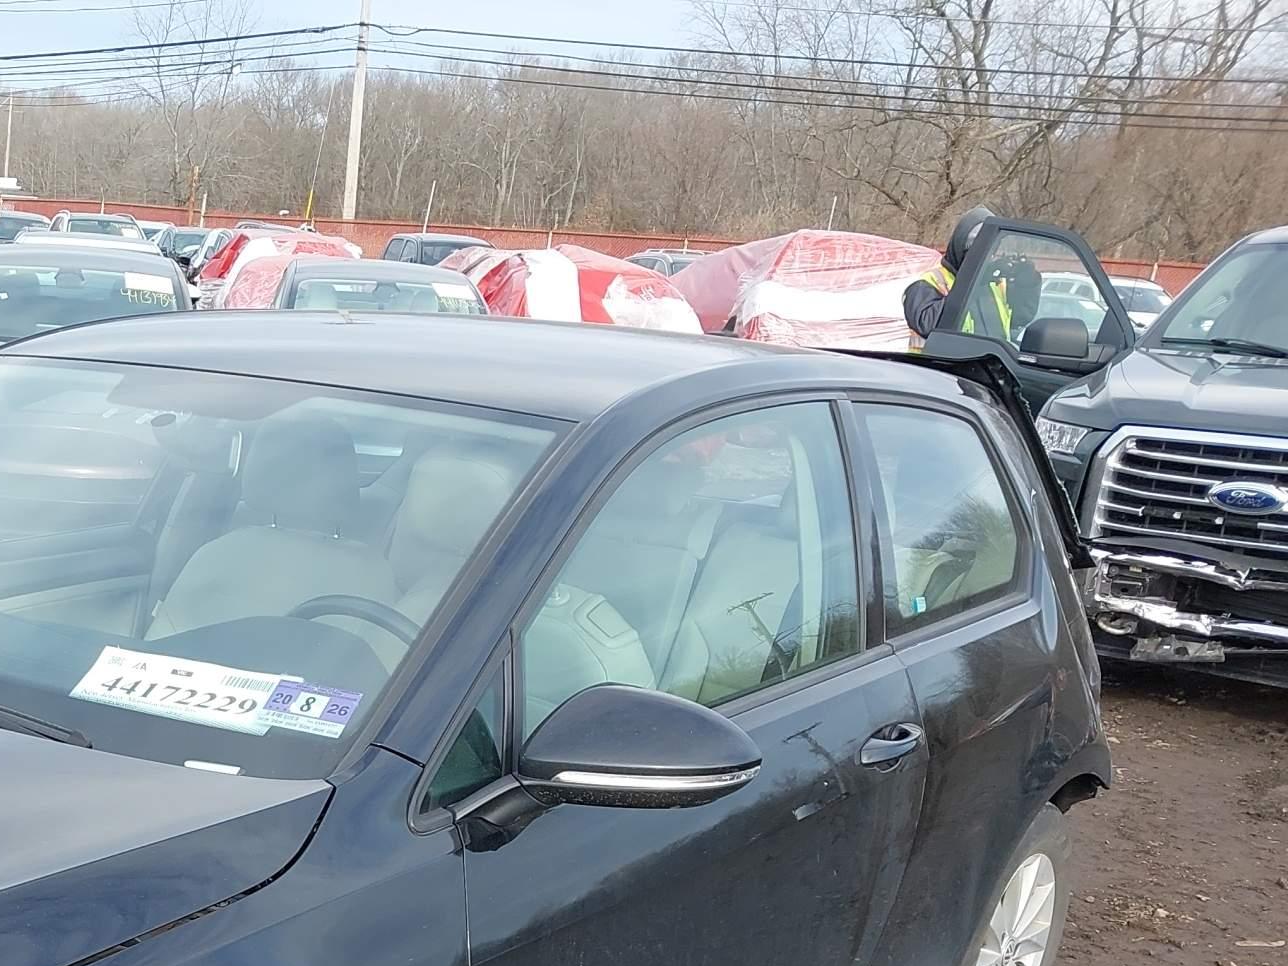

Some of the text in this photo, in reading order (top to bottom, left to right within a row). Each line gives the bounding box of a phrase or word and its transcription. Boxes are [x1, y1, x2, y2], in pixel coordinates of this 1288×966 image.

[1225, 490, 1266, 507] Ford
[101, 675, 258, 715] 44172229
[272, 692, 350, 716] 20 8 26
